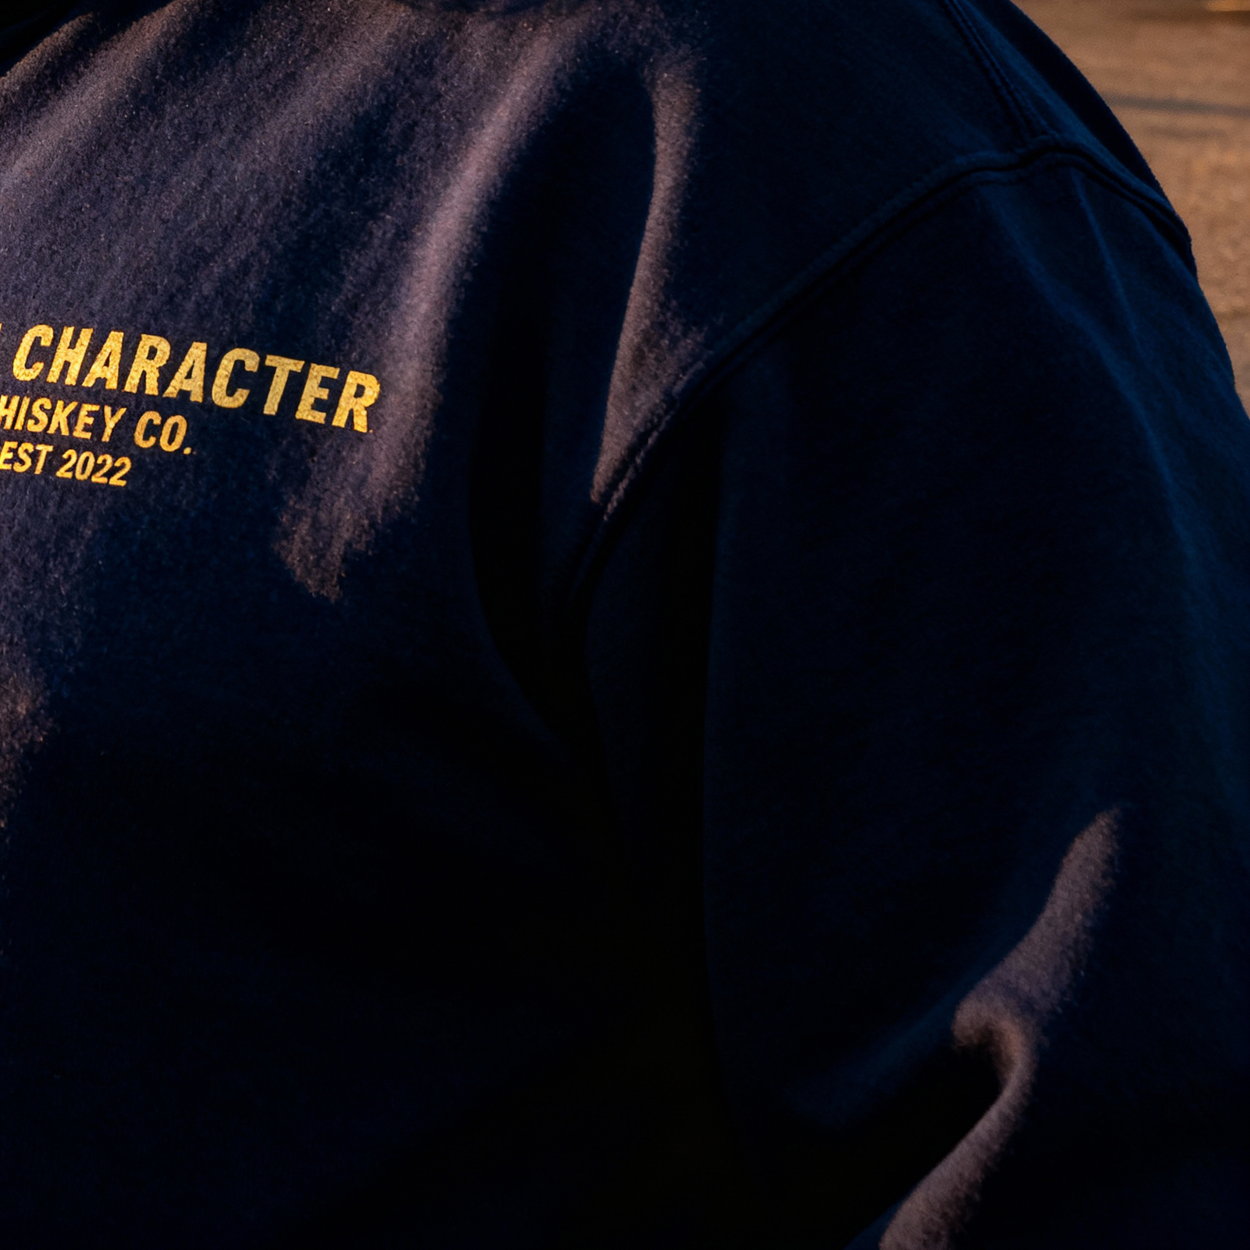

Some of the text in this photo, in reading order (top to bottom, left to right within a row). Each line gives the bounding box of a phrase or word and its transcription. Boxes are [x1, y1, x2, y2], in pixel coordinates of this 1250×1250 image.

[12, 324, 381, 433] CHARACTER
[134, 411, 192, 454] CO.
[56, 449, 131, 487] 2022
